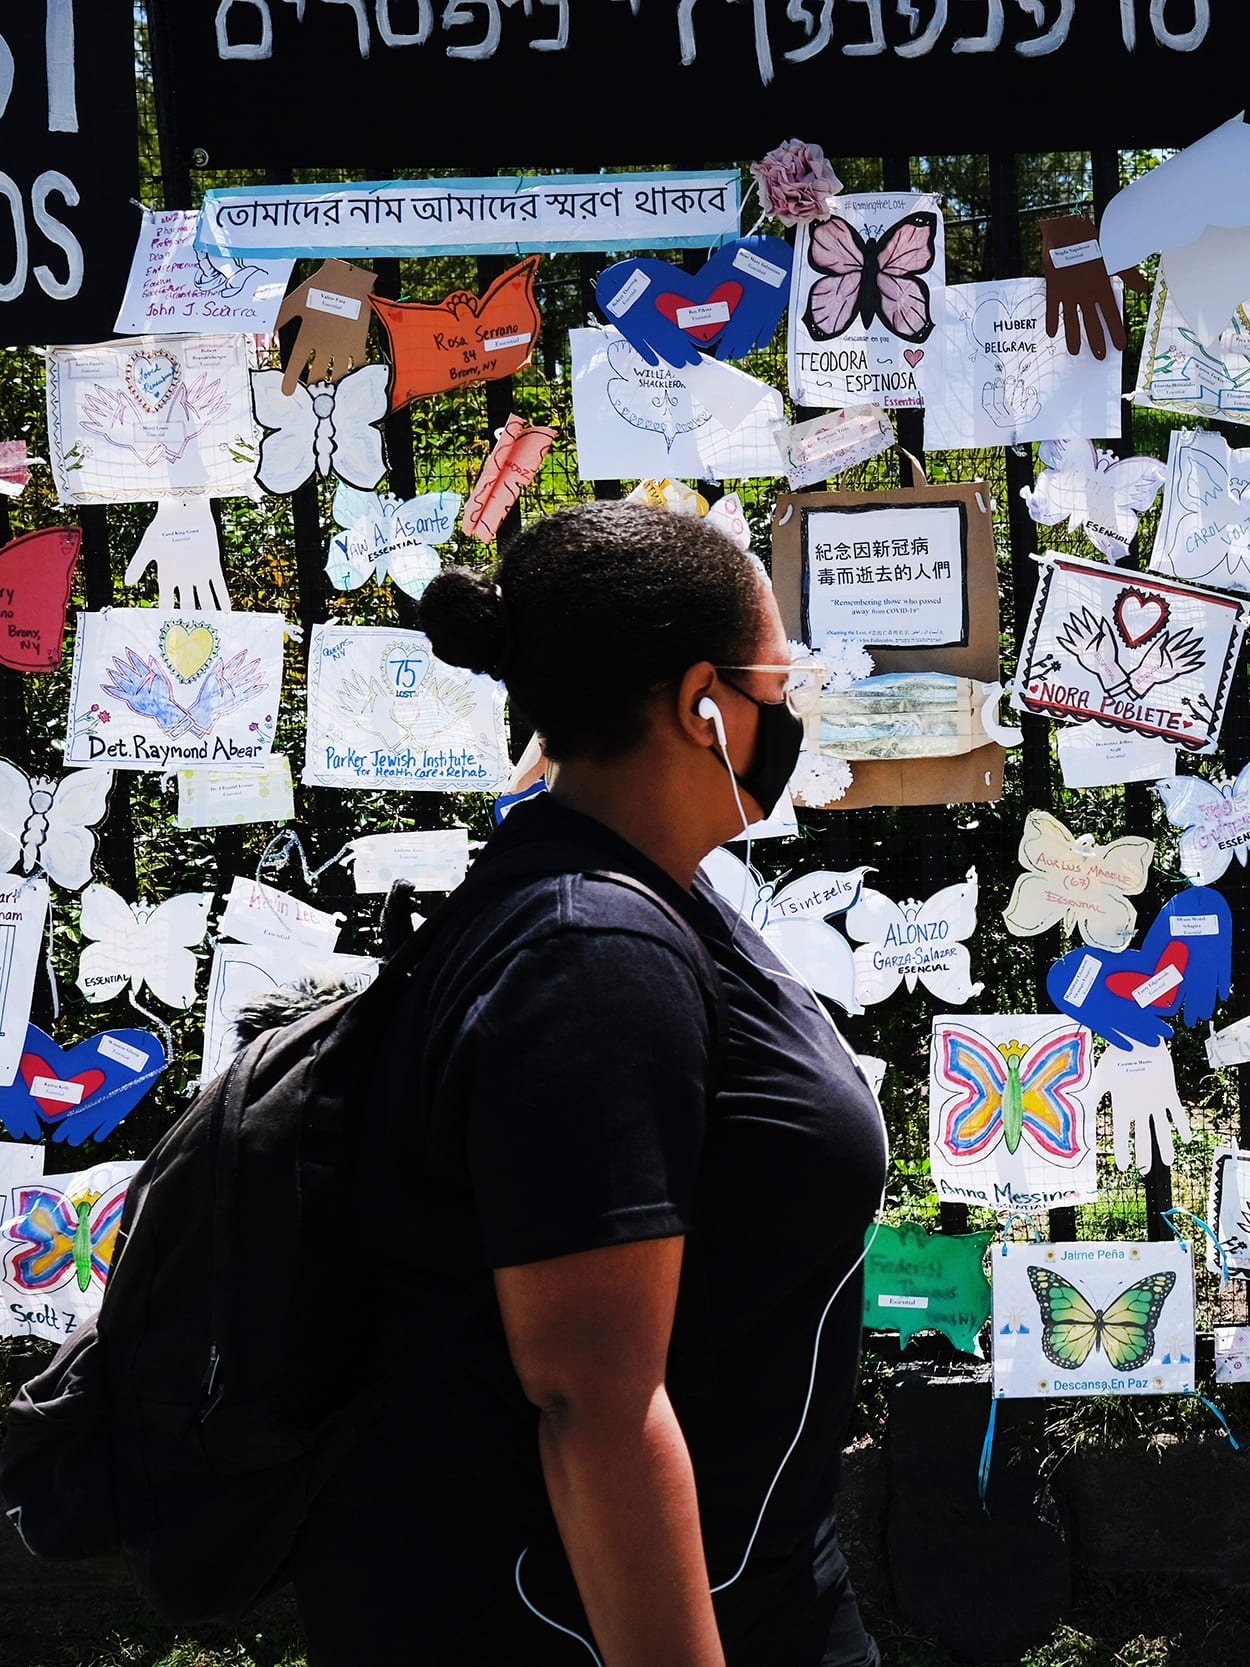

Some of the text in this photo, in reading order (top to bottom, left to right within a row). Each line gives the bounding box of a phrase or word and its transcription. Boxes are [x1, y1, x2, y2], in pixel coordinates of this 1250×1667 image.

[217, 184, 729, 229] তোমাদের নাম আমাদের স্মরণ থাকবে
[145, 301, 257, 318] John J. Sciarra
[993, 318, 1037, 331] HUBERT
[433, 323, 519, 351] Rosa Serrano
[984, 341, 1037, 354] BELGRAVE
[463, 349, 477, 364] 84
[482, 359, 498, 373] NY
[796, 349, 868, 372] TEODORA
[634, 368, 675, 379] WILLIA
[846, 372, 916, 393] ESPINOSA
[883, 396, 924, 407] Essential
[374, 510, 450, 544] A. Asante
[1185, 521, 1229, 553] CAROL
[368, 539, 422, 563] ESSENTIAL
[815, 536, 930, 562] 紀念因新冠病
[817, 560, 951, 586] 毒而逝去的人們
[919, 597, 942, 606] passed
[20, 640, 41, 655] NY
[389, 659, 423, 688] 75
[395, 690, 416, 698] LOST
[1039, 681, 1183, 730] NORA POBLETE
[88, 734, 262, 766] Det. Raymond Abear
[326, 746, 477, 769] Parker Jewish Institute
[354, 767, 371, 776] for
[1062, 875, 1090, 890] (67)
[772, 880, 852, 917] Tsintzelis
[884, 920, 948, 948] ALONZO
[84, 974, 129, 987] ESSENTIAL
[939, 1179, 1084, 1205] Anna Messina
[1060, 1248, 1126, 1262] Jaime Peña
[10, 1303, 60, 1331] Scott
[1053, 1378, 1150, 1392] Descansa En Paz
